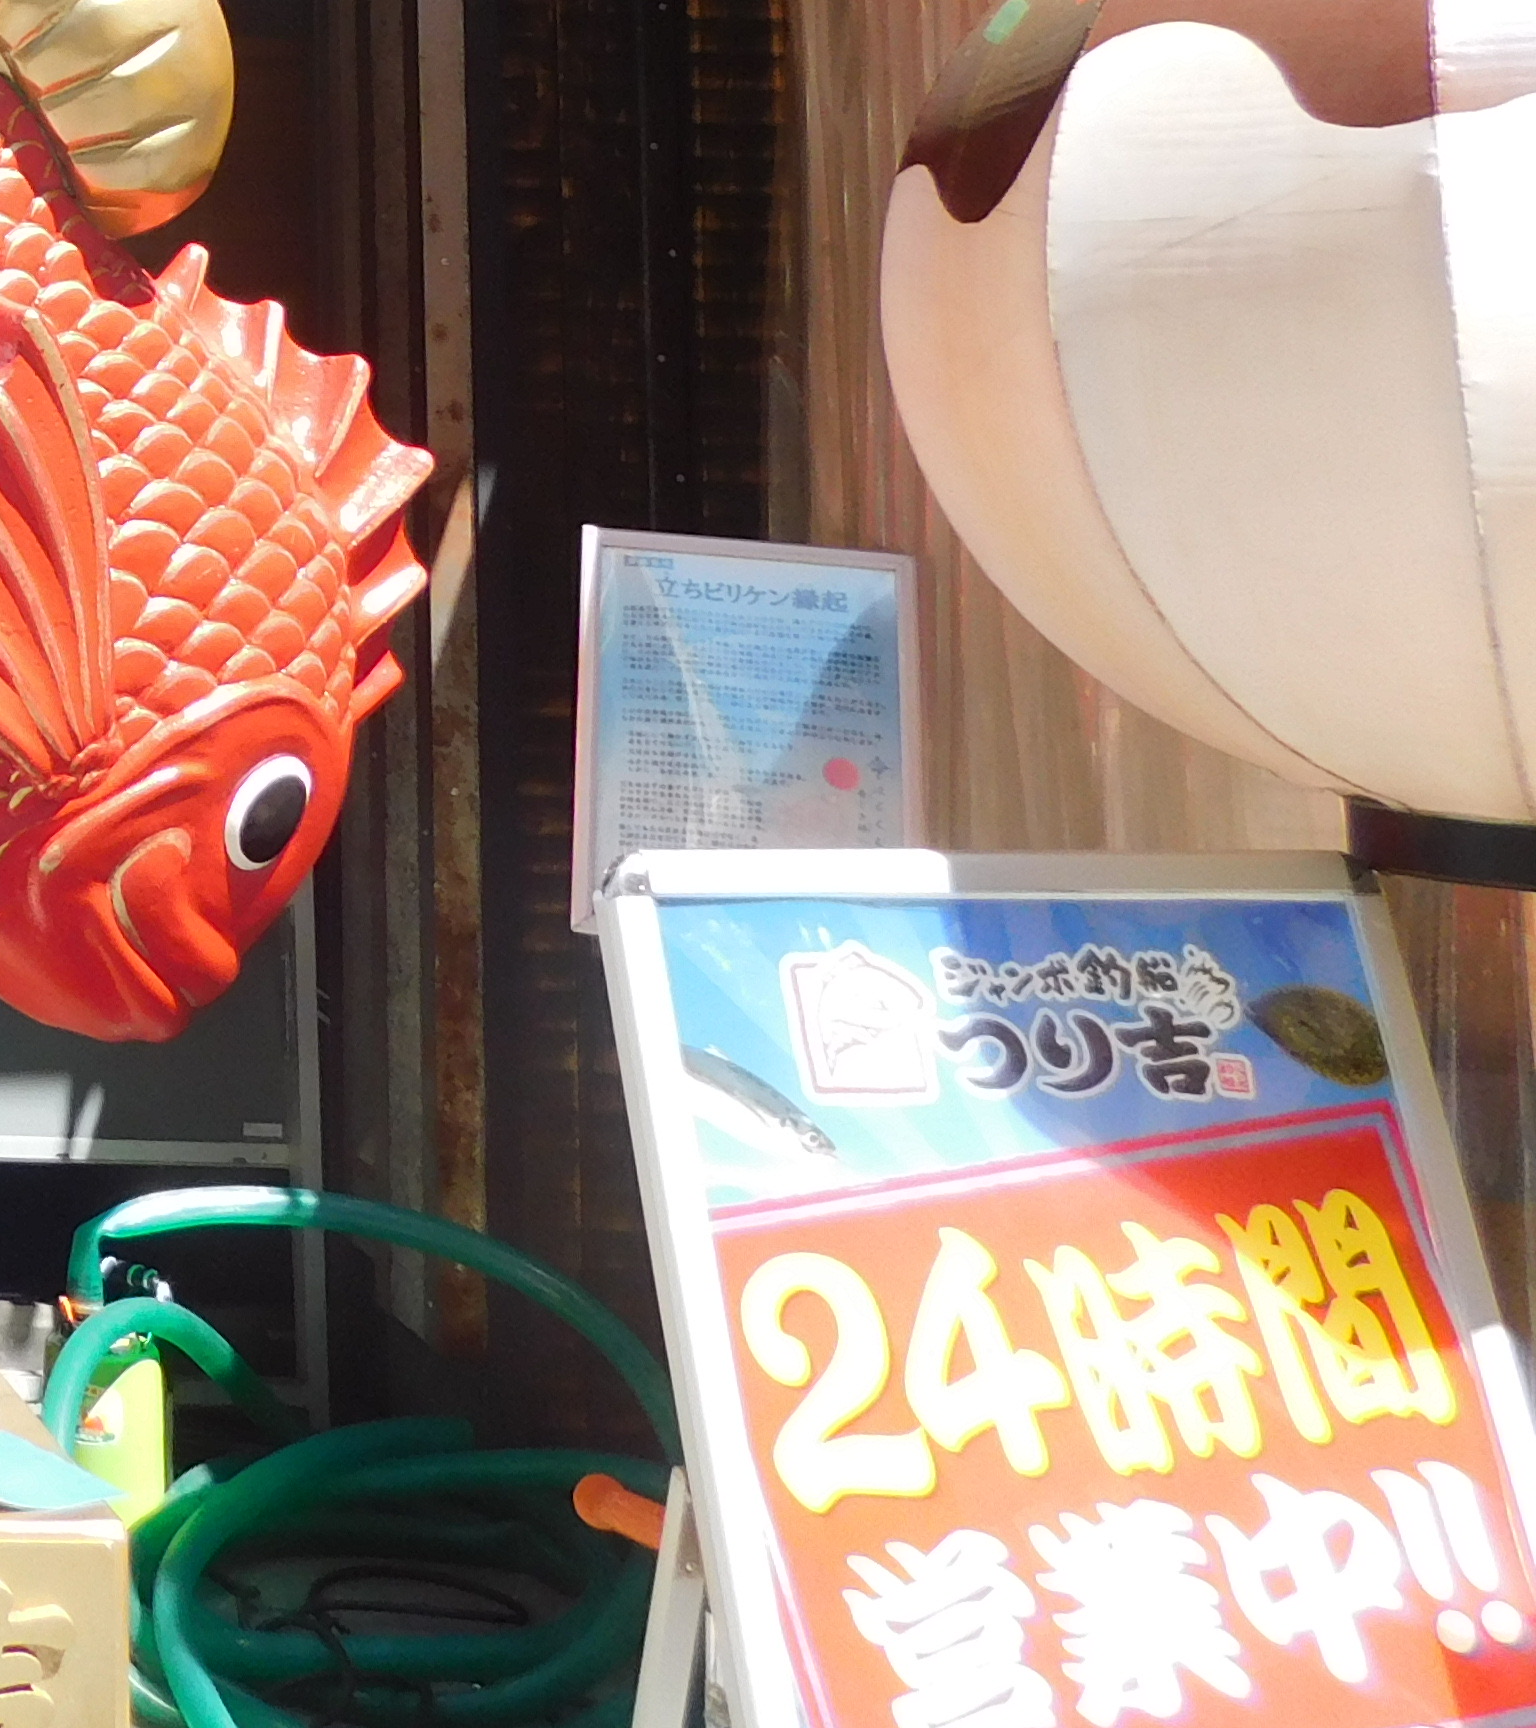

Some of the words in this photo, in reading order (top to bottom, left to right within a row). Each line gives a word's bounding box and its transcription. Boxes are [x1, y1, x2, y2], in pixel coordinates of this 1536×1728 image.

[937, 1006, 1213, 1095] つり吉
[740, 1189, 1457, 1513] 24時間
